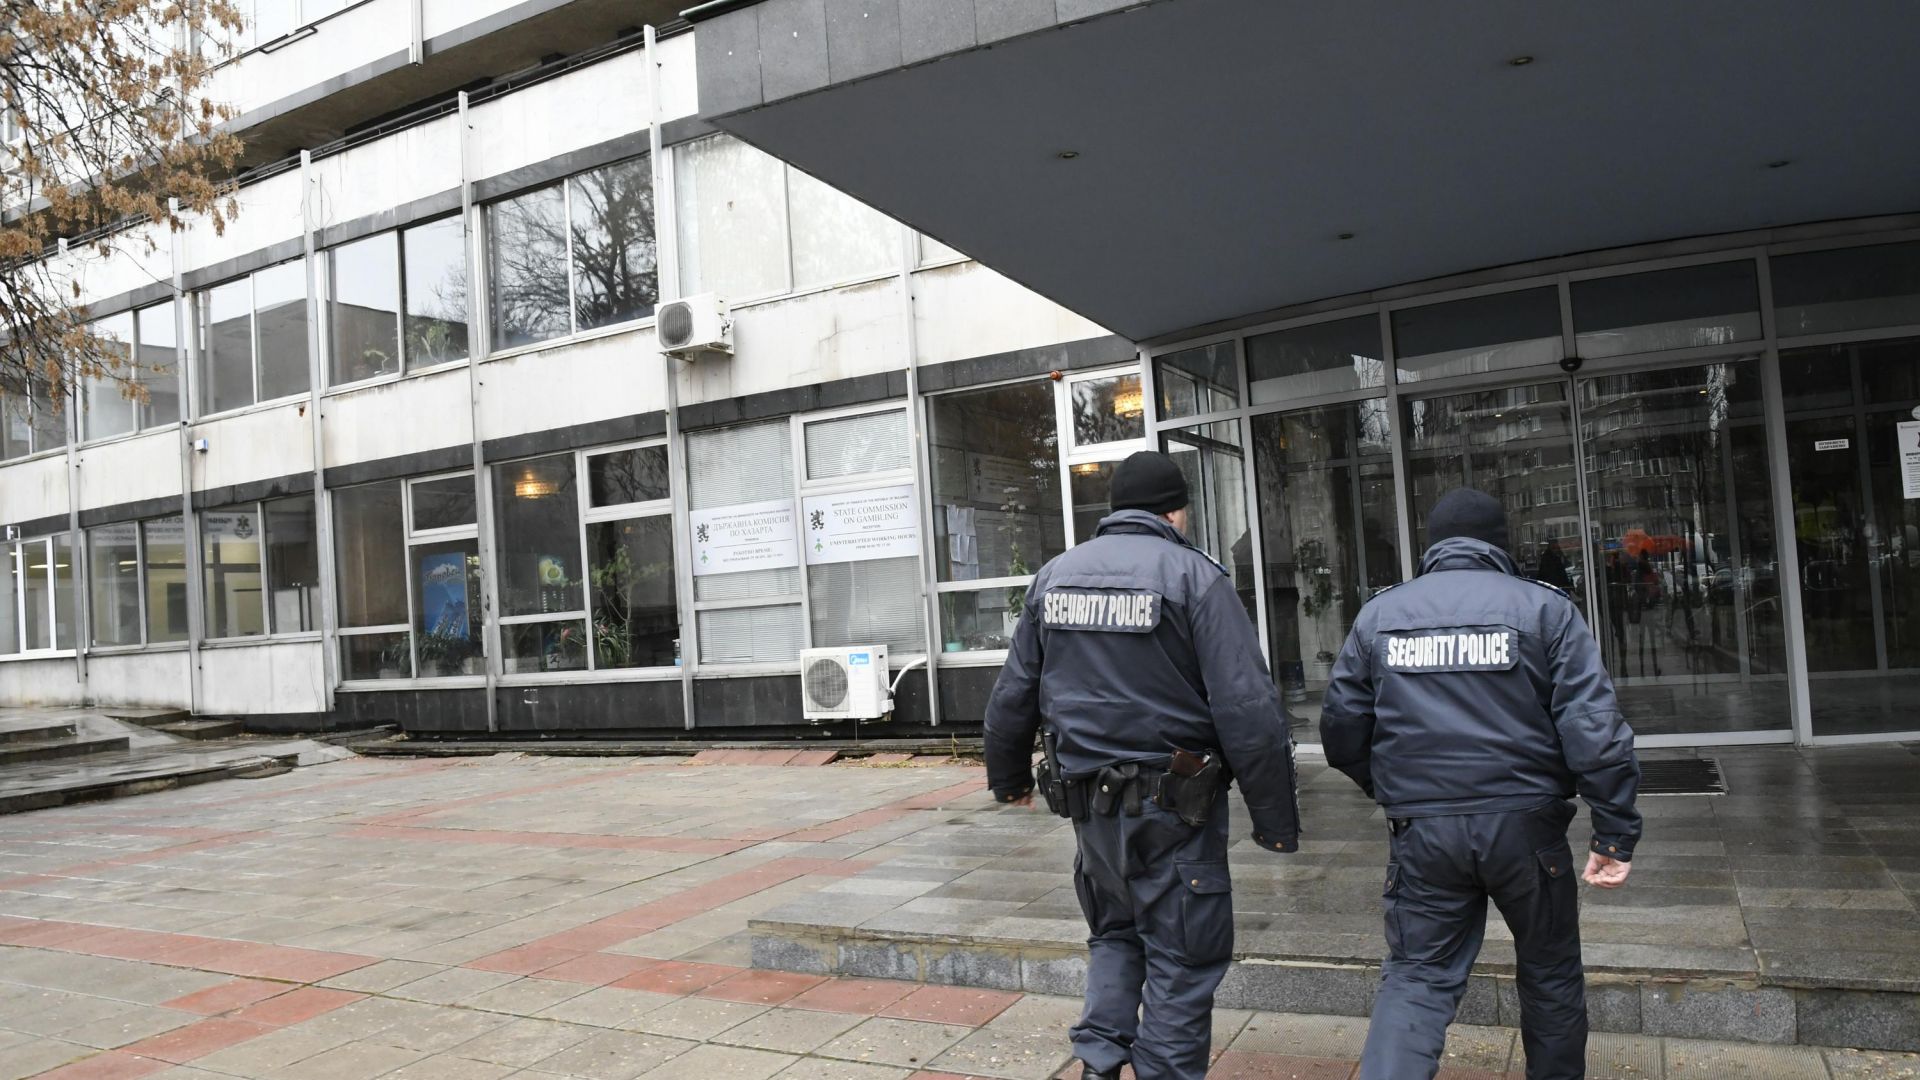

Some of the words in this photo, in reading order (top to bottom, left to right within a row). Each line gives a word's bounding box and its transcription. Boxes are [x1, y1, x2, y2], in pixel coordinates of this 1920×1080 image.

[834, 507, 856, 517] STATE
[857, 502, 908, 513] COMMISSION
[713, 520, 753, 532] ДЪРЖАВНА
[753, 515, 790, 527] КОМИСИЯ
[843, 515, 853, 525] ON
[856, 512, 899, 523] GAMBLING
[729, 529, 740, 537] ПО
[741, 526, 774, 536] ХАЗАРТА
[1044, 593, 1108, 625] SECURITY
[1108, 595, 1153, 626] POLICE
[1387, 635, 1456, 666] SECURITY
[1458, 632, 1510, 665] POLICE
